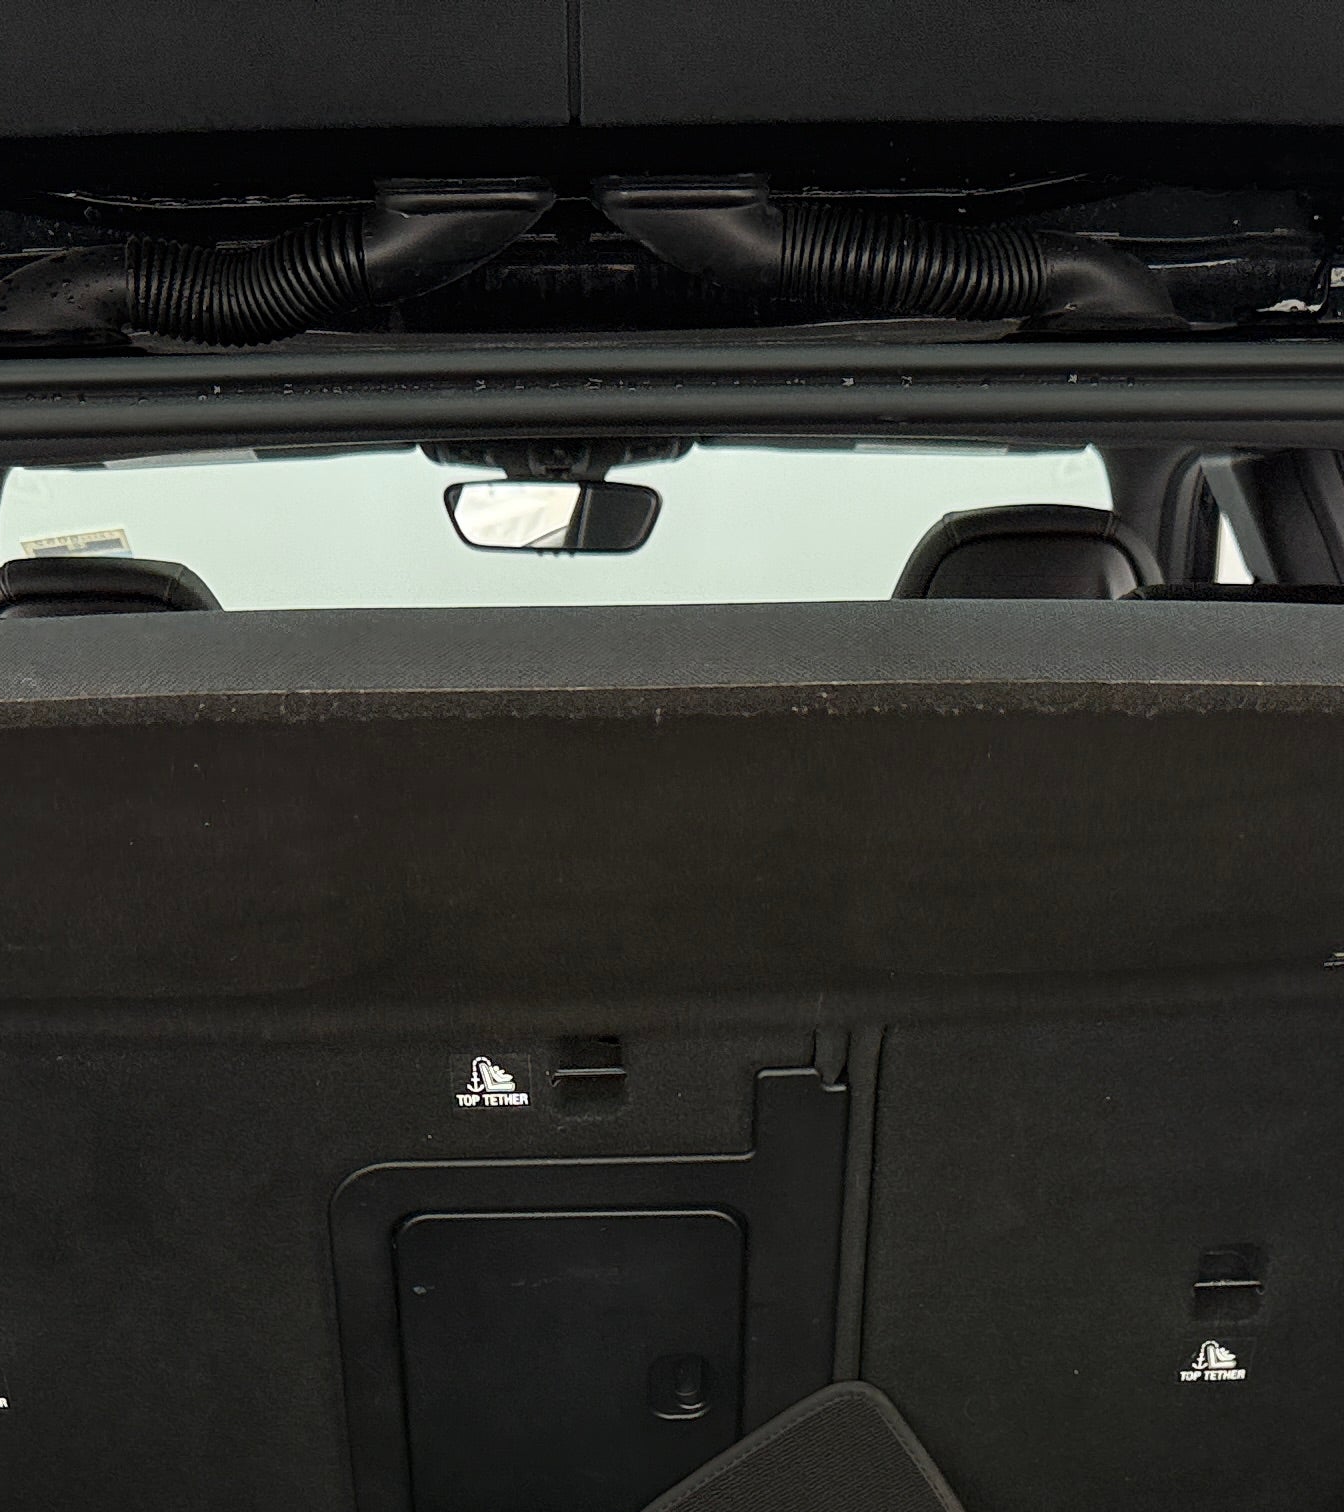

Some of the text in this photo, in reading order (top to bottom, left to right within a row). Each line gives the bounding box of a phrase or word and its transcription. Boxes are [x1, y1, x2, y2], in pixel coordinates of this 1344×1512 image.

[456, 1093, 529, 1106] TOP TETHER
[1180, 1369, 1246, 1381] TOP TETHER
